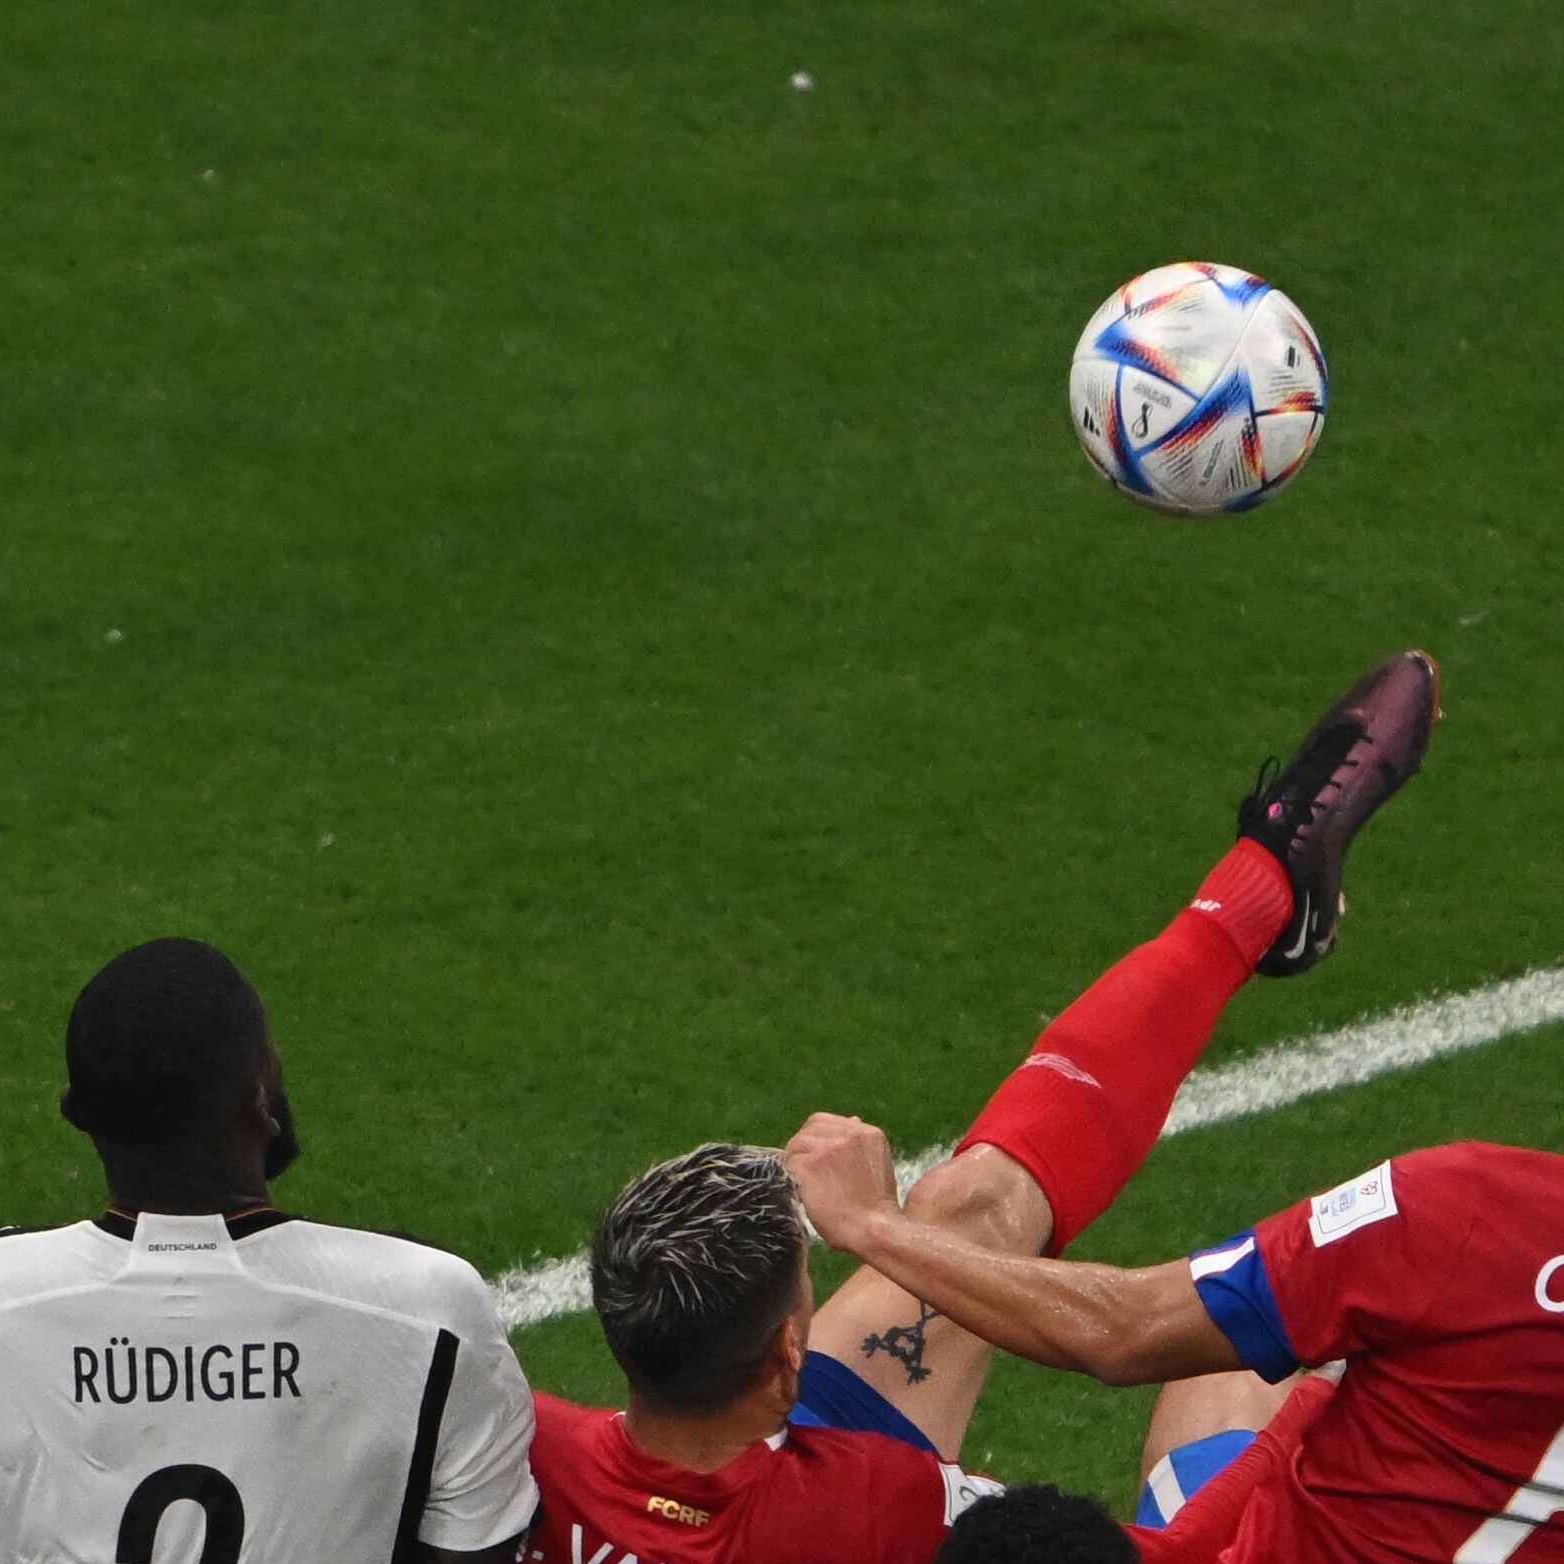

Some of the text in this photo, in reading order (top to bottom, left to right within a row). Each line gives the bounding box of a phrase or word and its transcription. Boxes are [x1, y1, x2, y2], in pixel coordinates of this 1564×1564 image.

[148, 1243, 217, 1252] DEUTSCHLAND
[73, 1337, 302, 1404] RÜDIGER
[648, 1496, 710, 1527] FCRF
